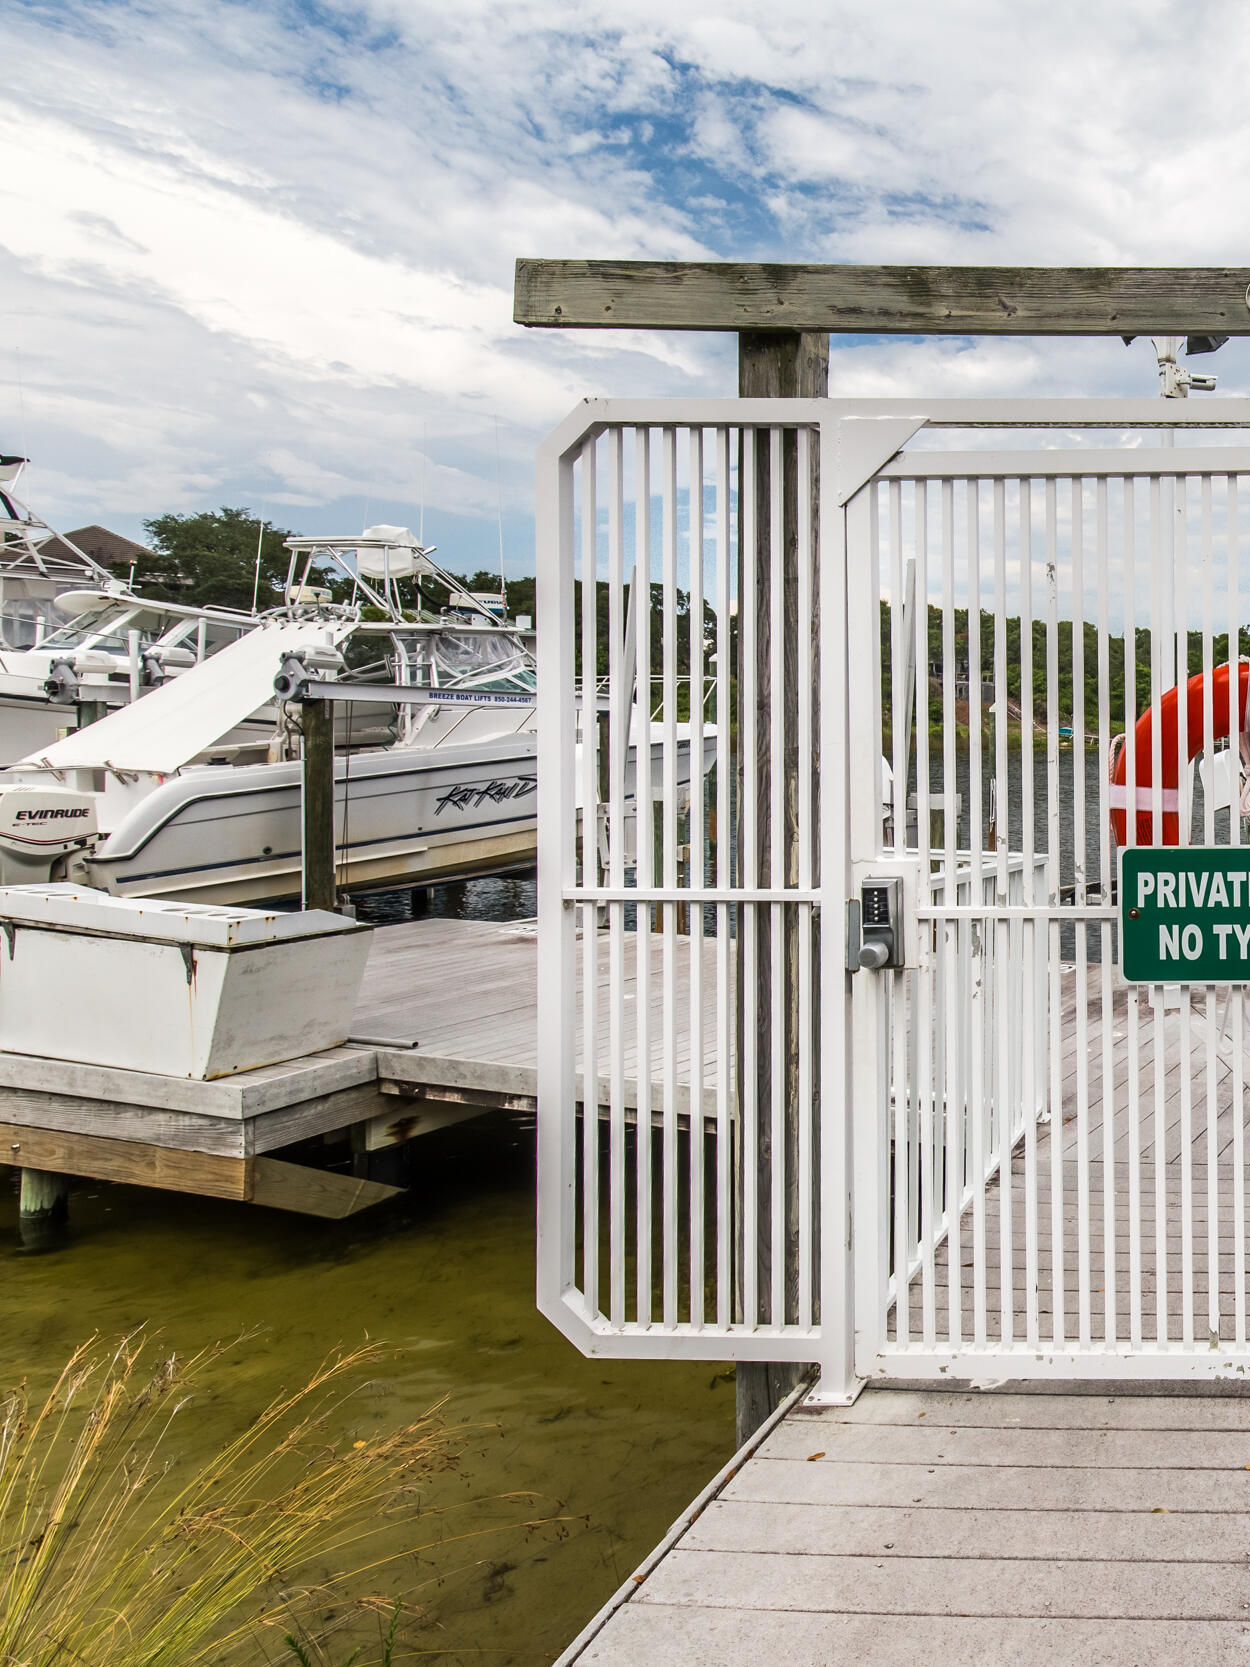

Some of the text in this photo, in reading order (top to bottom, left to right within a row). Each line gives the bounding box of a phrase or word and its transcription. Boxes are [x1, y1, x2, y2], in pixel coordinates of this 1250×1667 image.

[429, 692, 454, 700] BREEZE
[15, 808, 90, 820] EVINRUDE
[1159, 924, 1203, 960] NO
